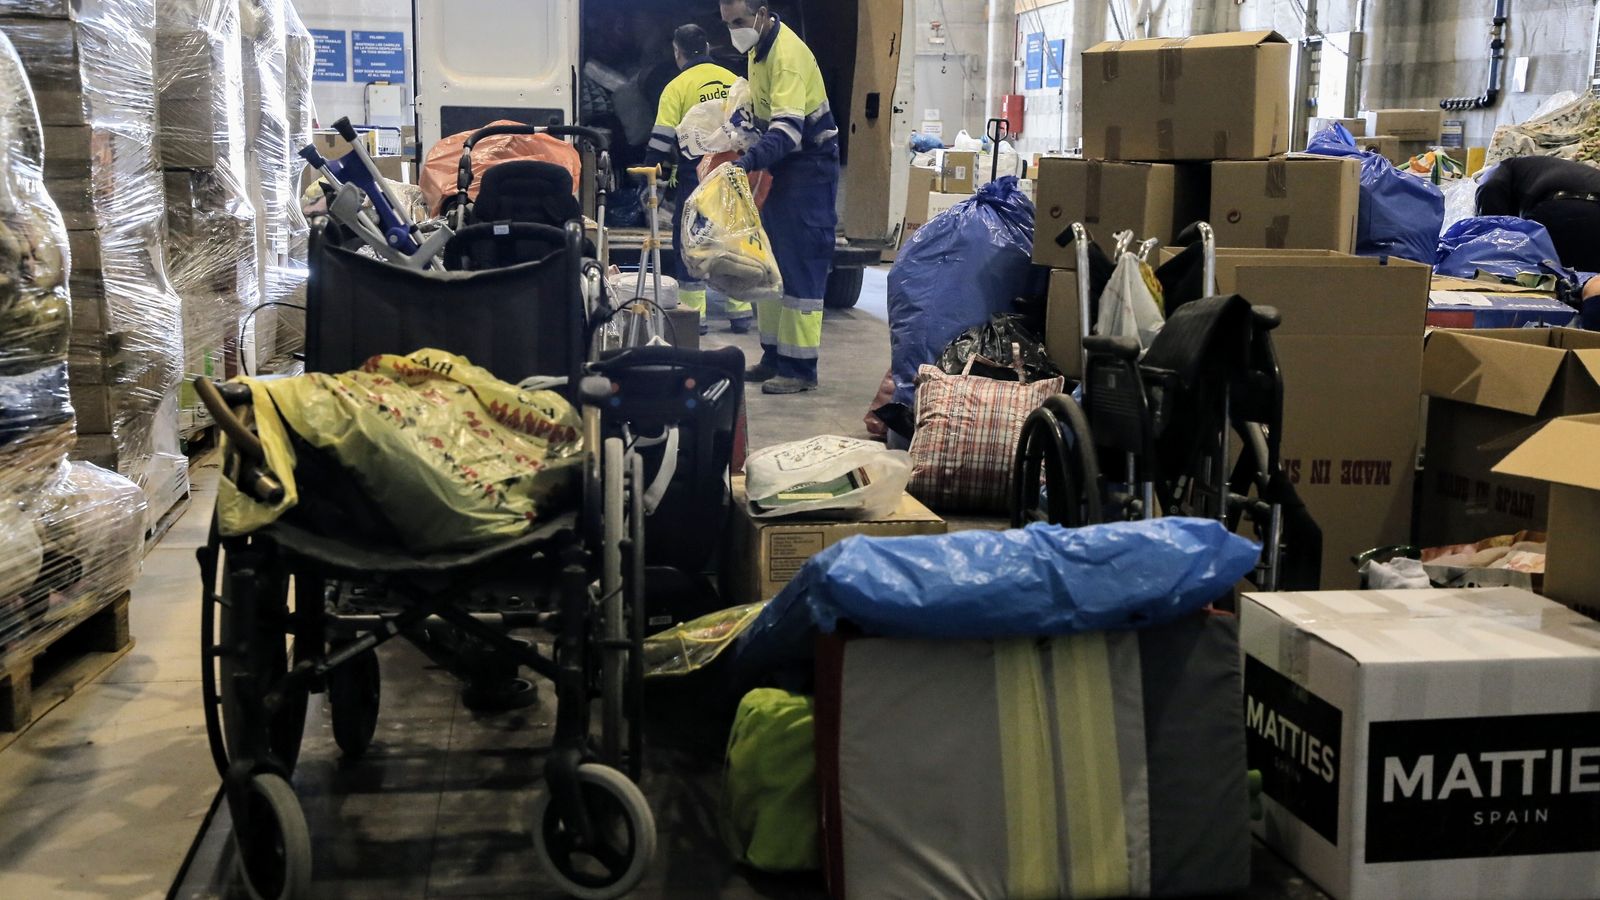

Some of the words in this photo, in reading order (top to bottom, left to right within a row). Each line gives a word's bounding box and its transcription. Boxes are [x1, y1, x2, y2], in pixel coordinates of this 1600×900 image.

[699, 88, 730, 103] aude
[1310, 460, 1332, 484] IN
[1341, 460, 1392, 485] MADE
[1495, 486, 1536, 520] SPAIN
[1246, 693, 1336, 785] MATTIES
[1473, 808, 1550, 826] SPAIN
